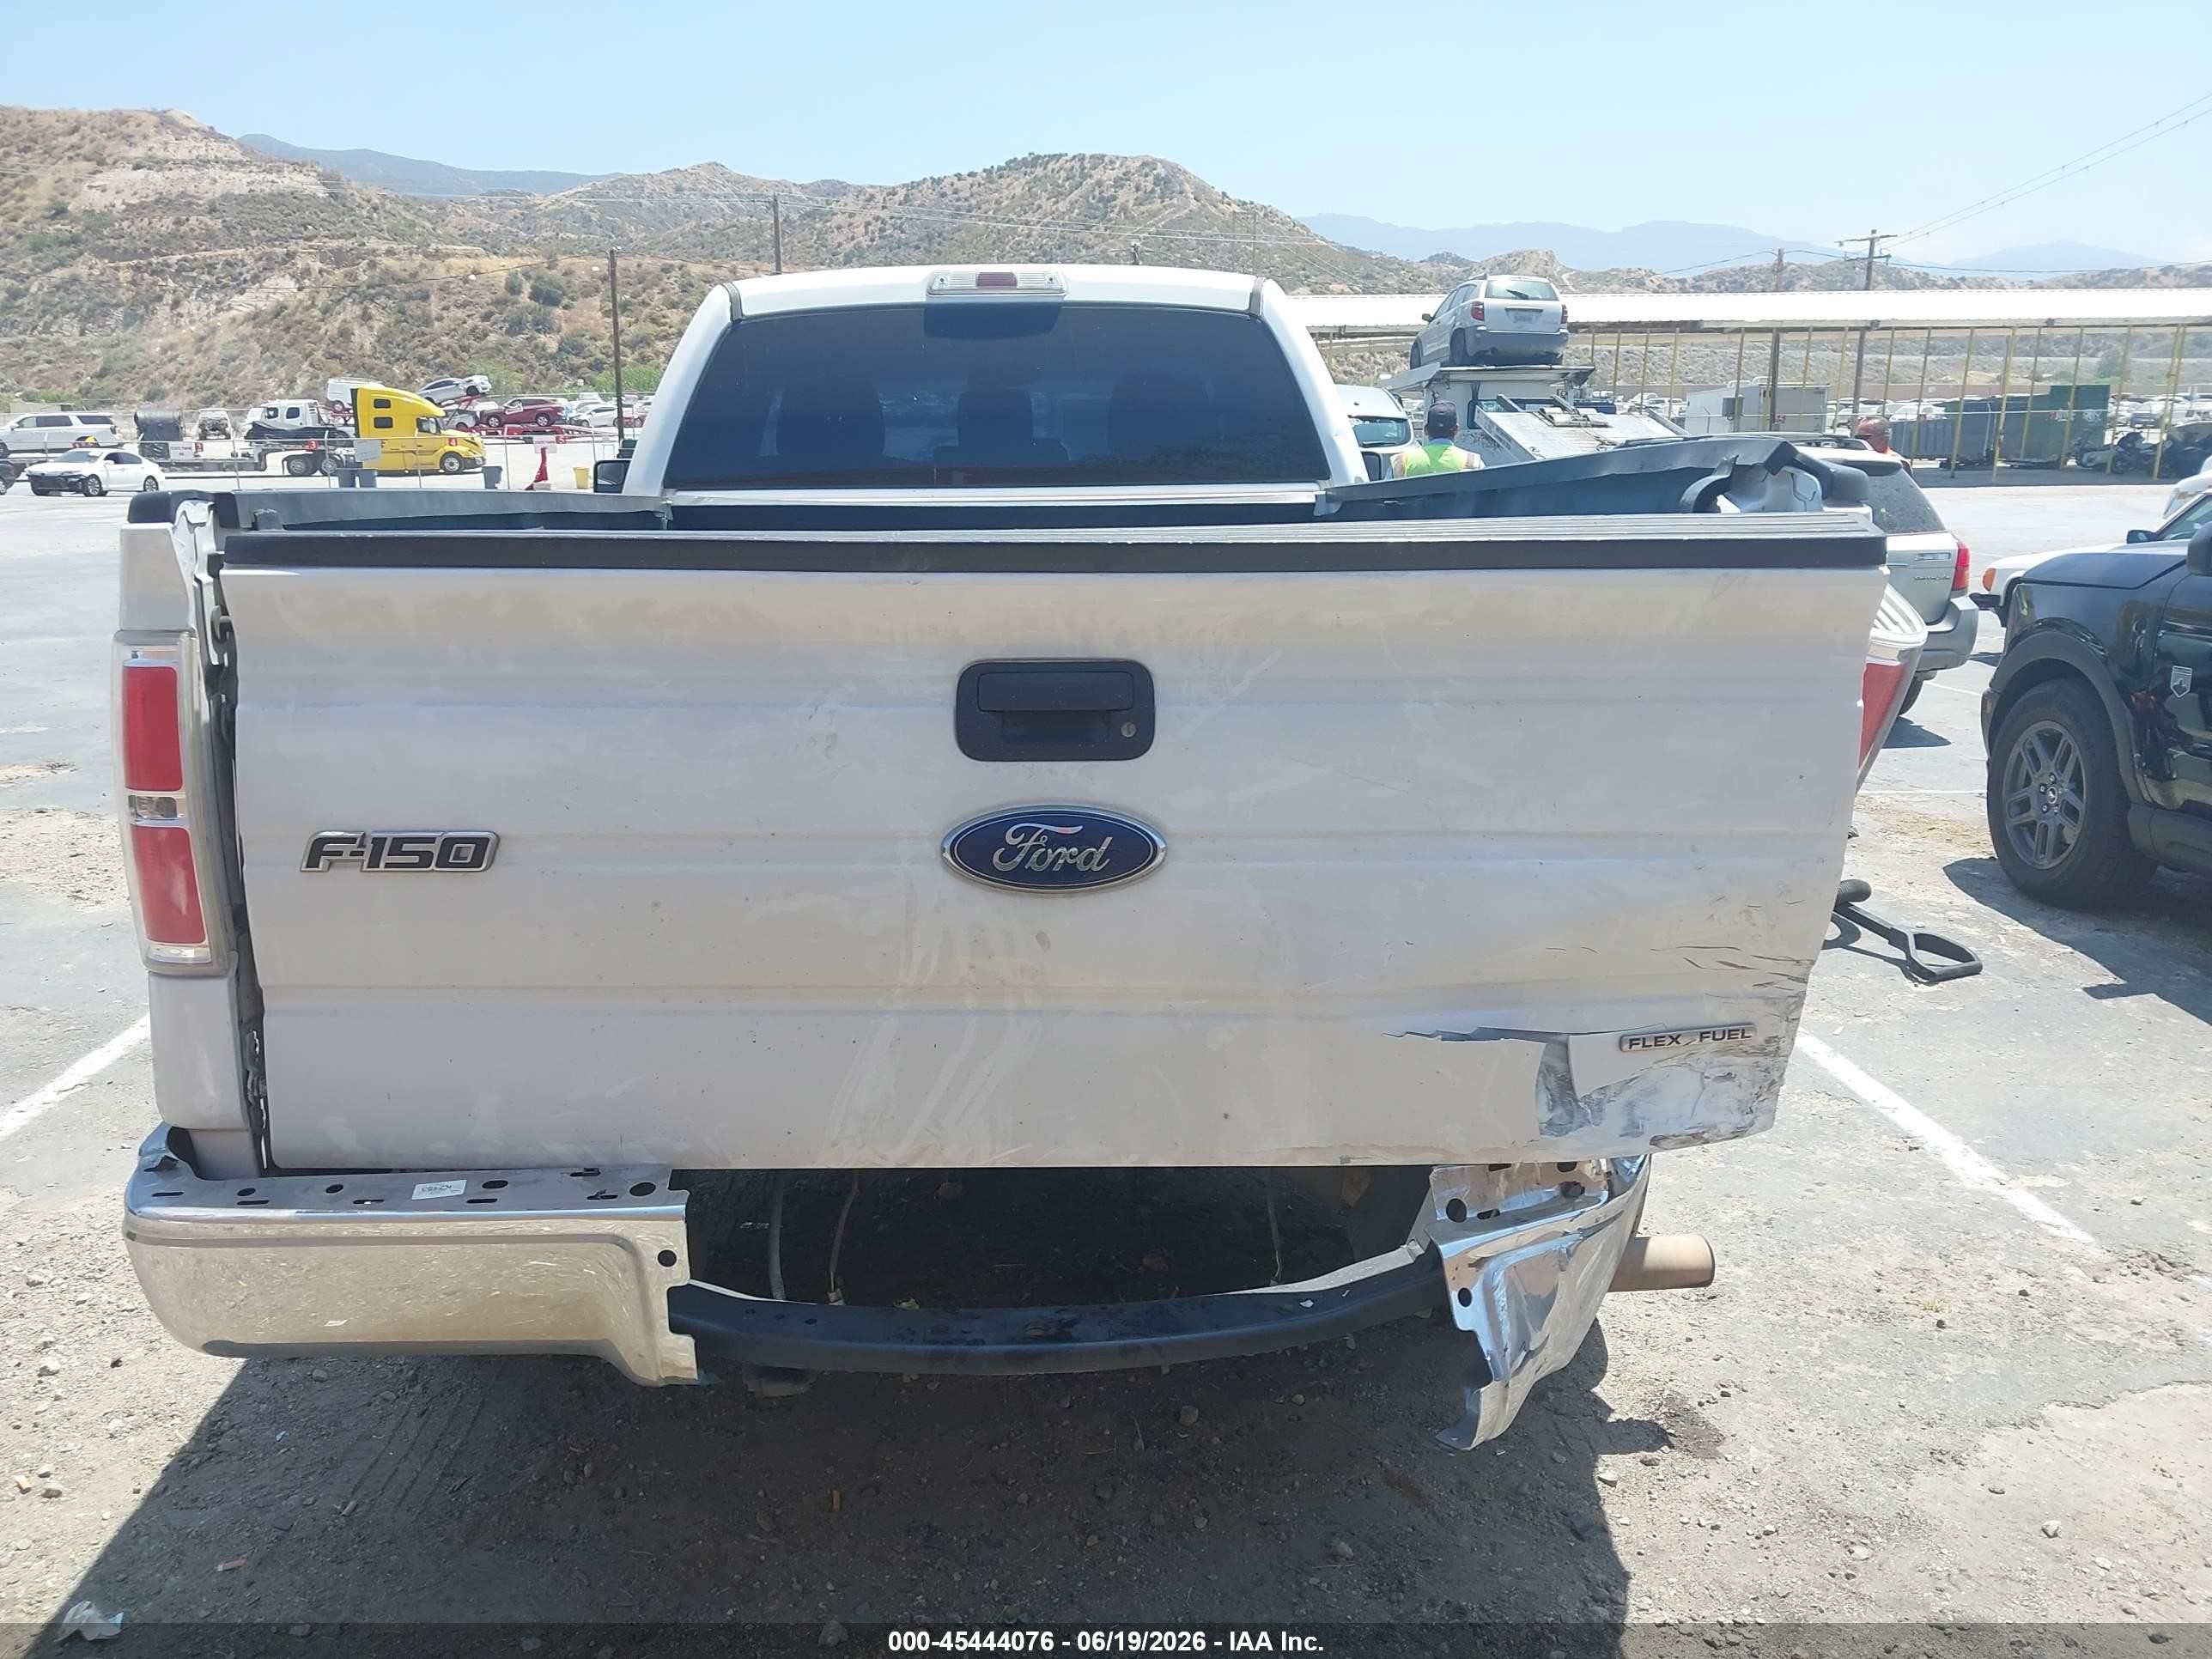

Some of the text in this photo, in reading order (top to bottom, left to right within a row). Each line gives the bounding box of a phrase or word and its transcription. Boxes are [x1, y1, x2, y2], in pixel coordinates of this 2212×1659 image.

[301, 831, 499, 872] F-150
[993, 823, 1113, 872] Ford
[1628, 1028, 1753, 1049] FLEX FUEL
